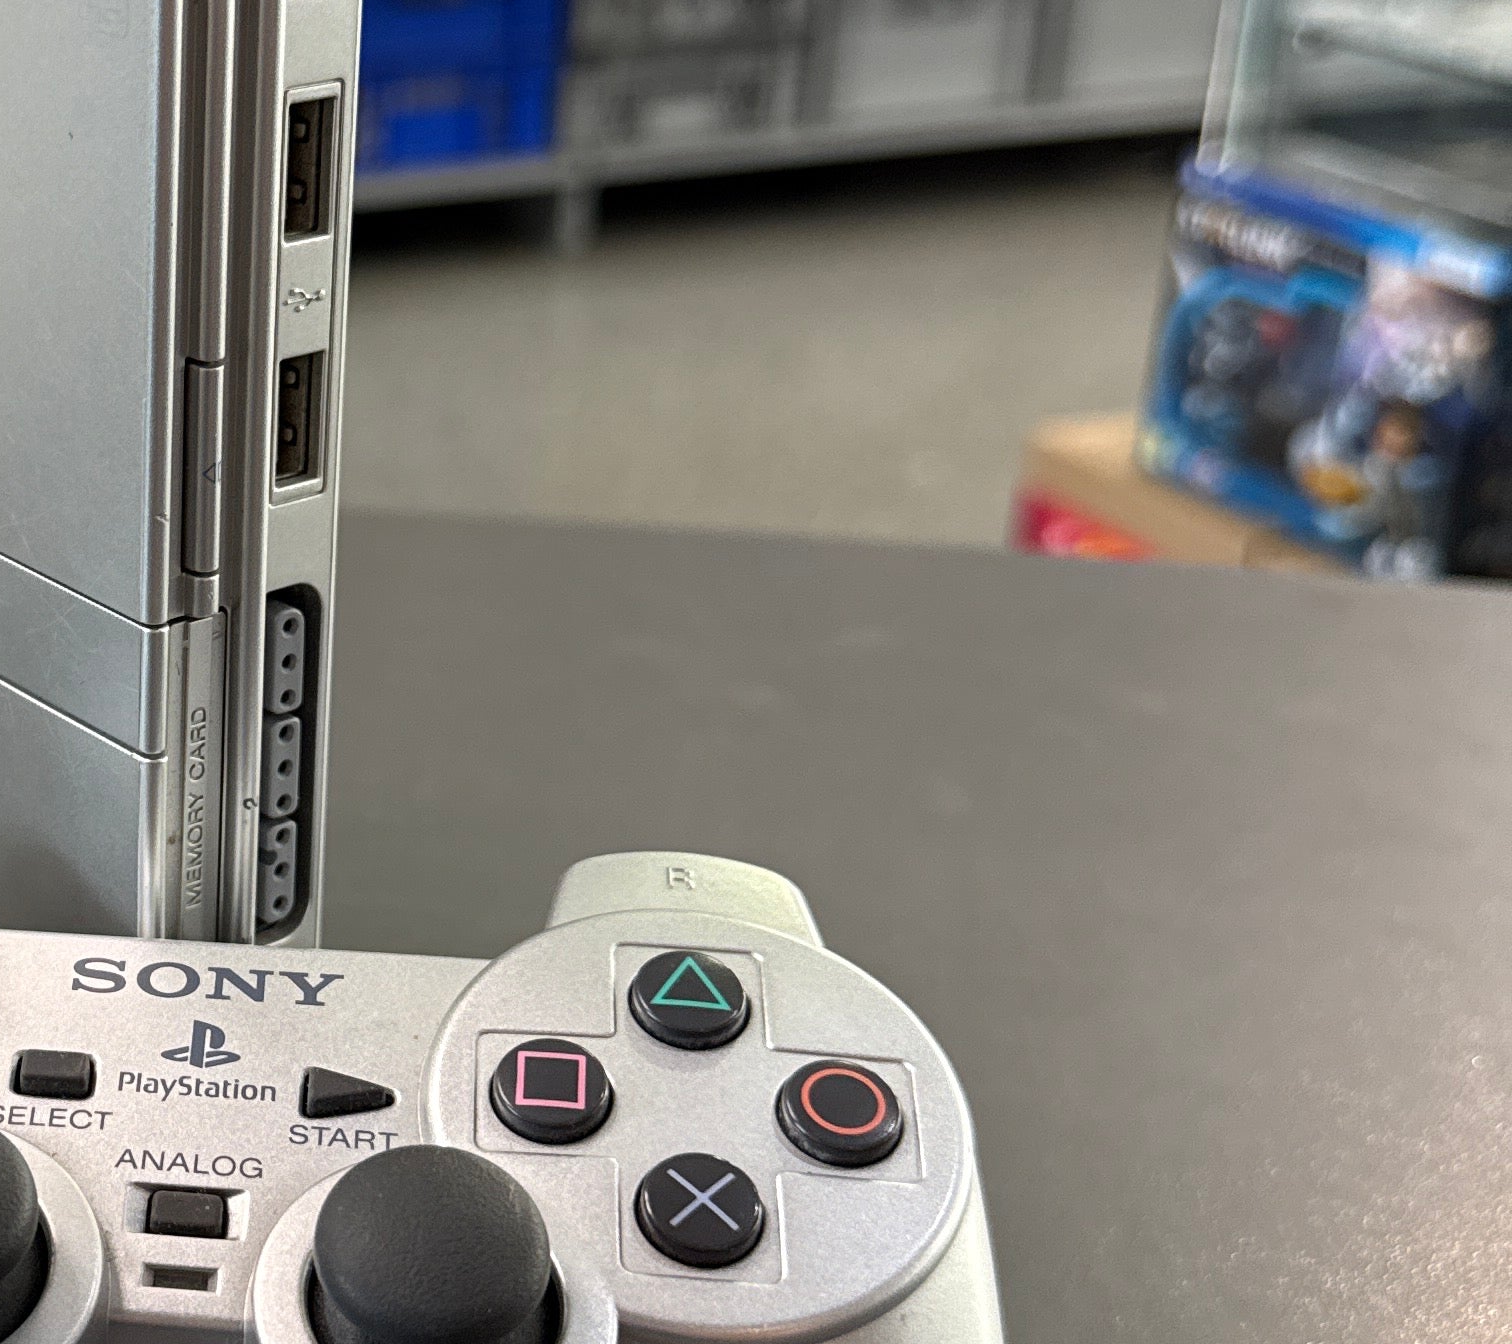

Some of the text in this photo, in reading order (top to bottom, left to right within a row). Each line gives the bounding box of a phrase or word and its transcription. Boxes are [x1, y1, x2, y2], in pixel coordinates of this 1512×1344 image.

[184, 706, 207, 910] MEMORY CARD
[666, 867, 696, 890] R
[71, 956, 345, 1007] SONY
[117, 1071, 277, 1103] PlayStation
[288, 1123, 399, 1151] START
[114, 1148, 264, 1180] ANALOG
